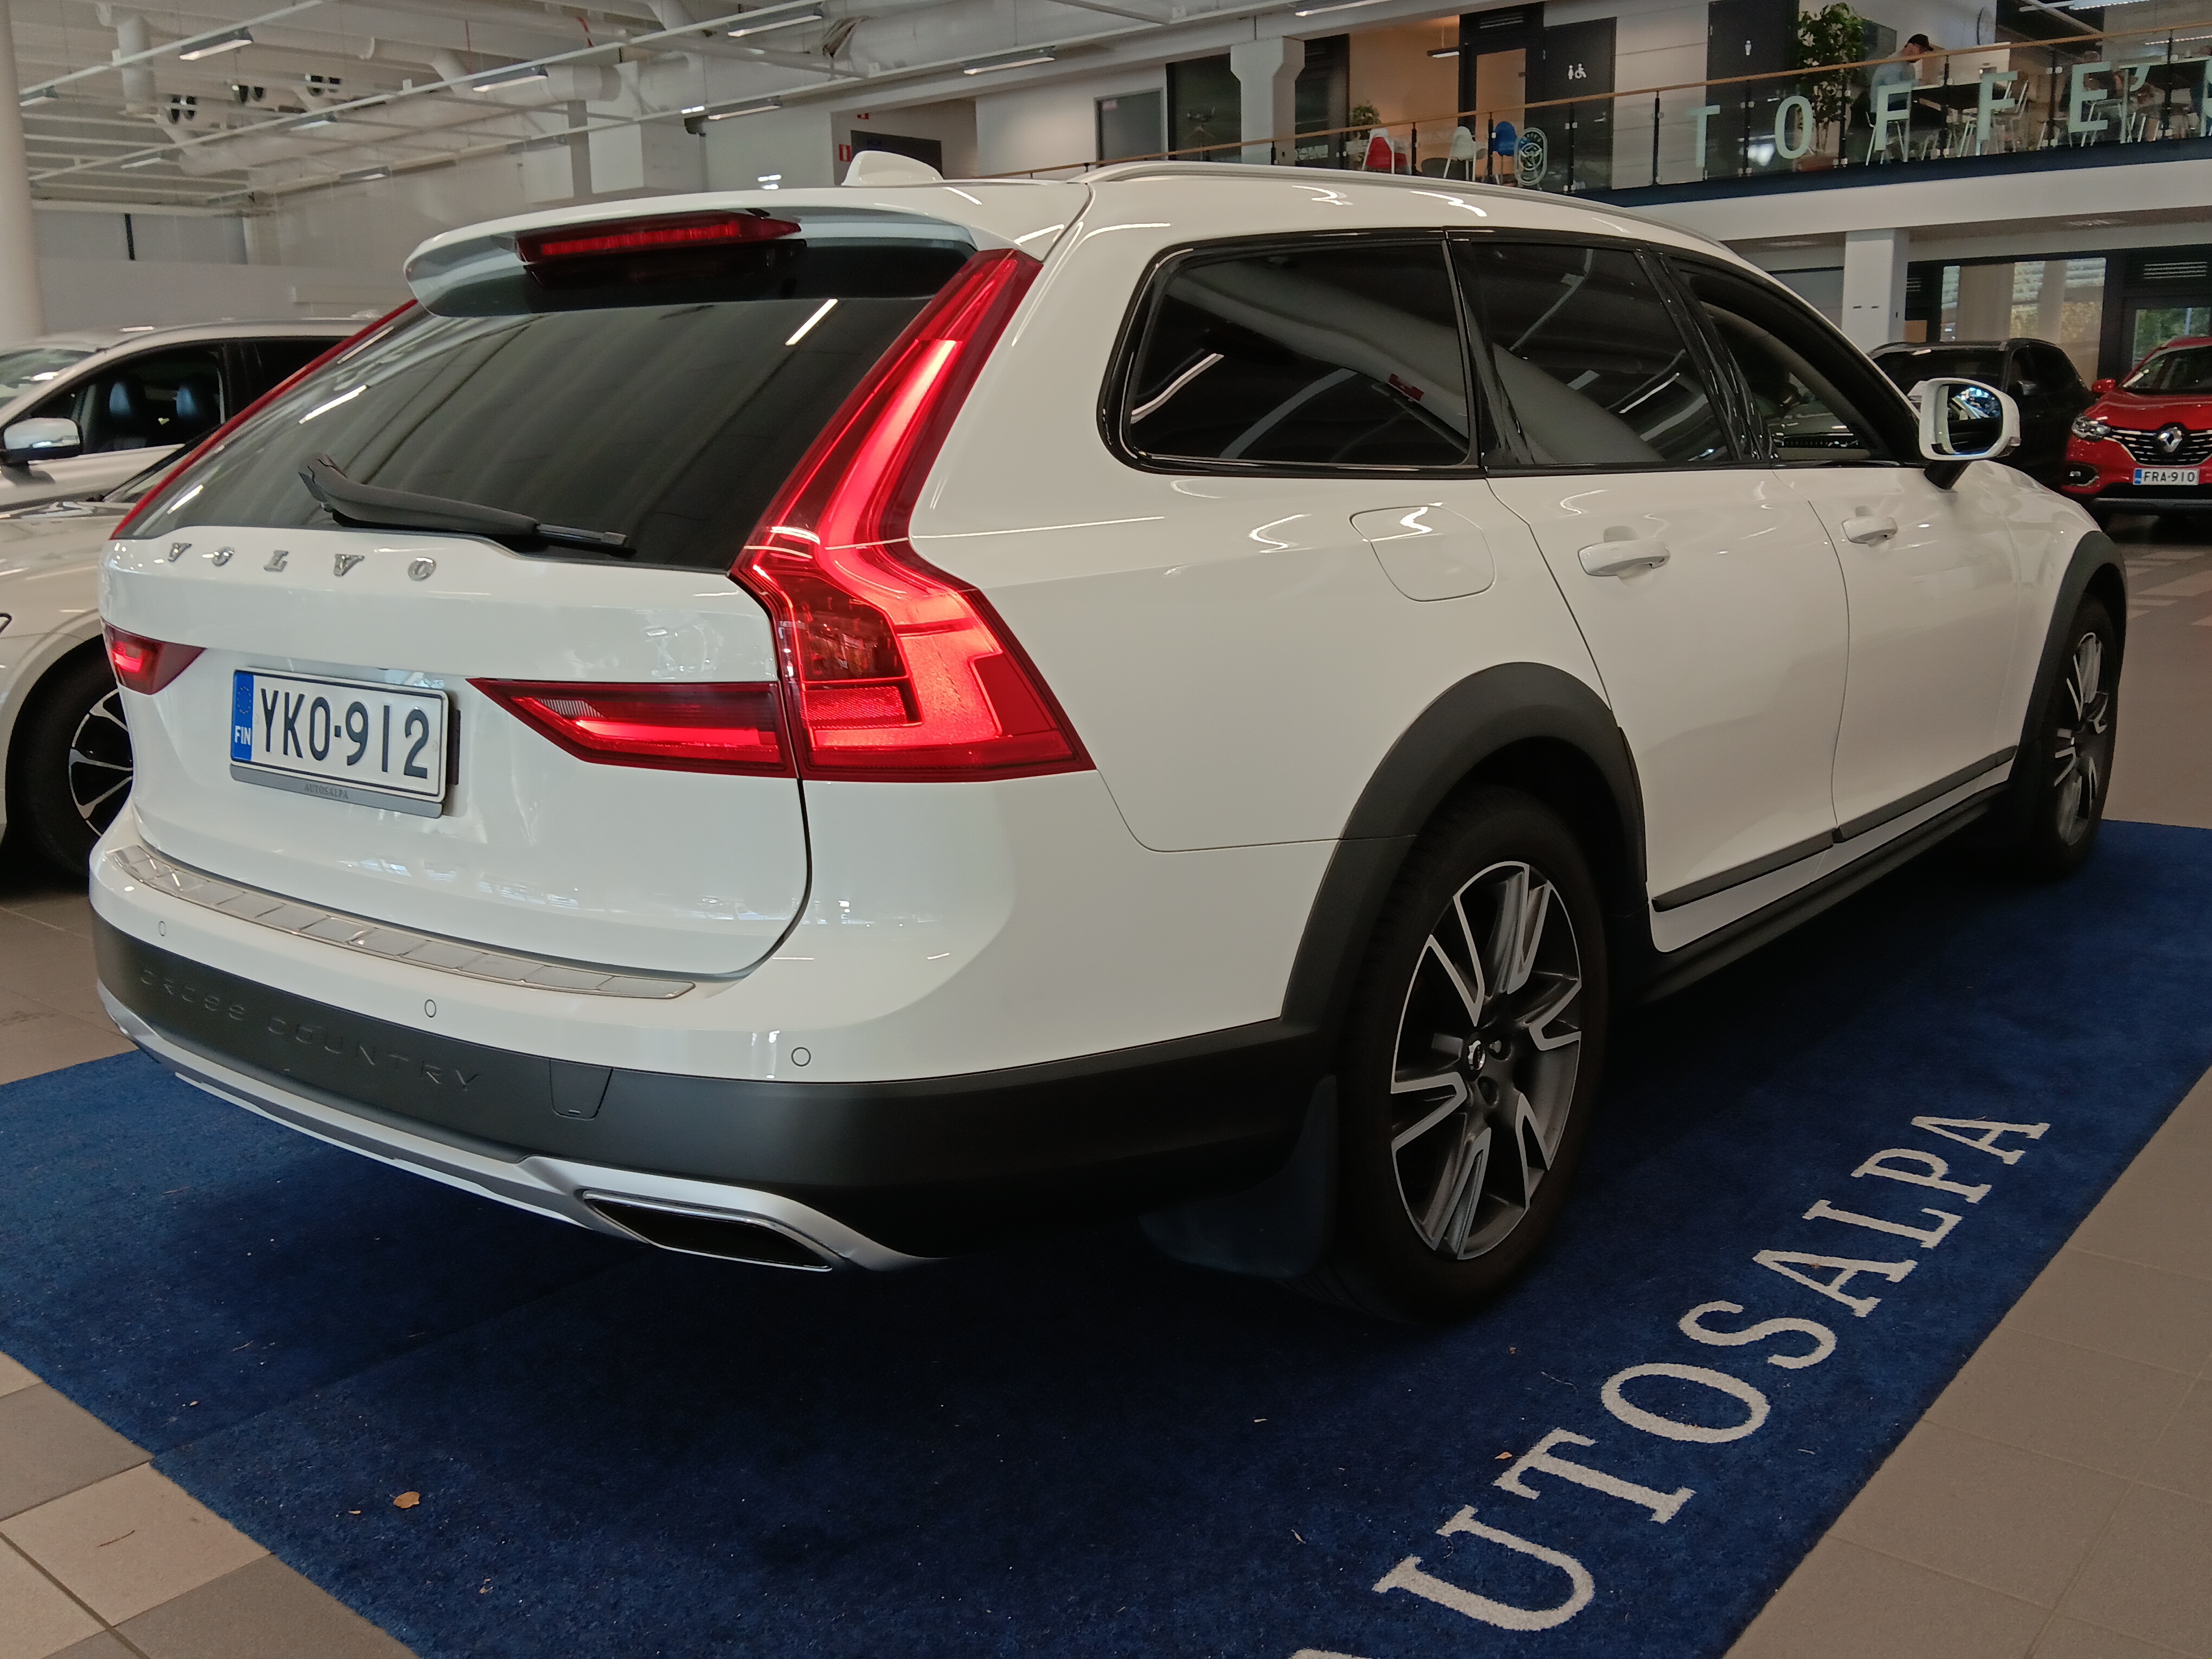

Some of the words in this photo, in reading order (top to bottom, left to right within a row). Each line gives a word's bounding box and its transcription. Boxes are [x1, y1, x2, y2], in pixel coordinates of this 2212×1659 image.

[2144, 471, 2195, 482] FRA-910
[168, 543, 436, 581] VOLVO
[235, 725, 251, 745] FIN
[261, 689, 429, 779] YKO-912
[304, 783, 349, 800] AUTOSALPA
[140, 969, 245, 1021] CROSS
[268, 1017, 479, 1091] COUNTRY
[1287, 1115, 2051, 1659] UTOSALPA
